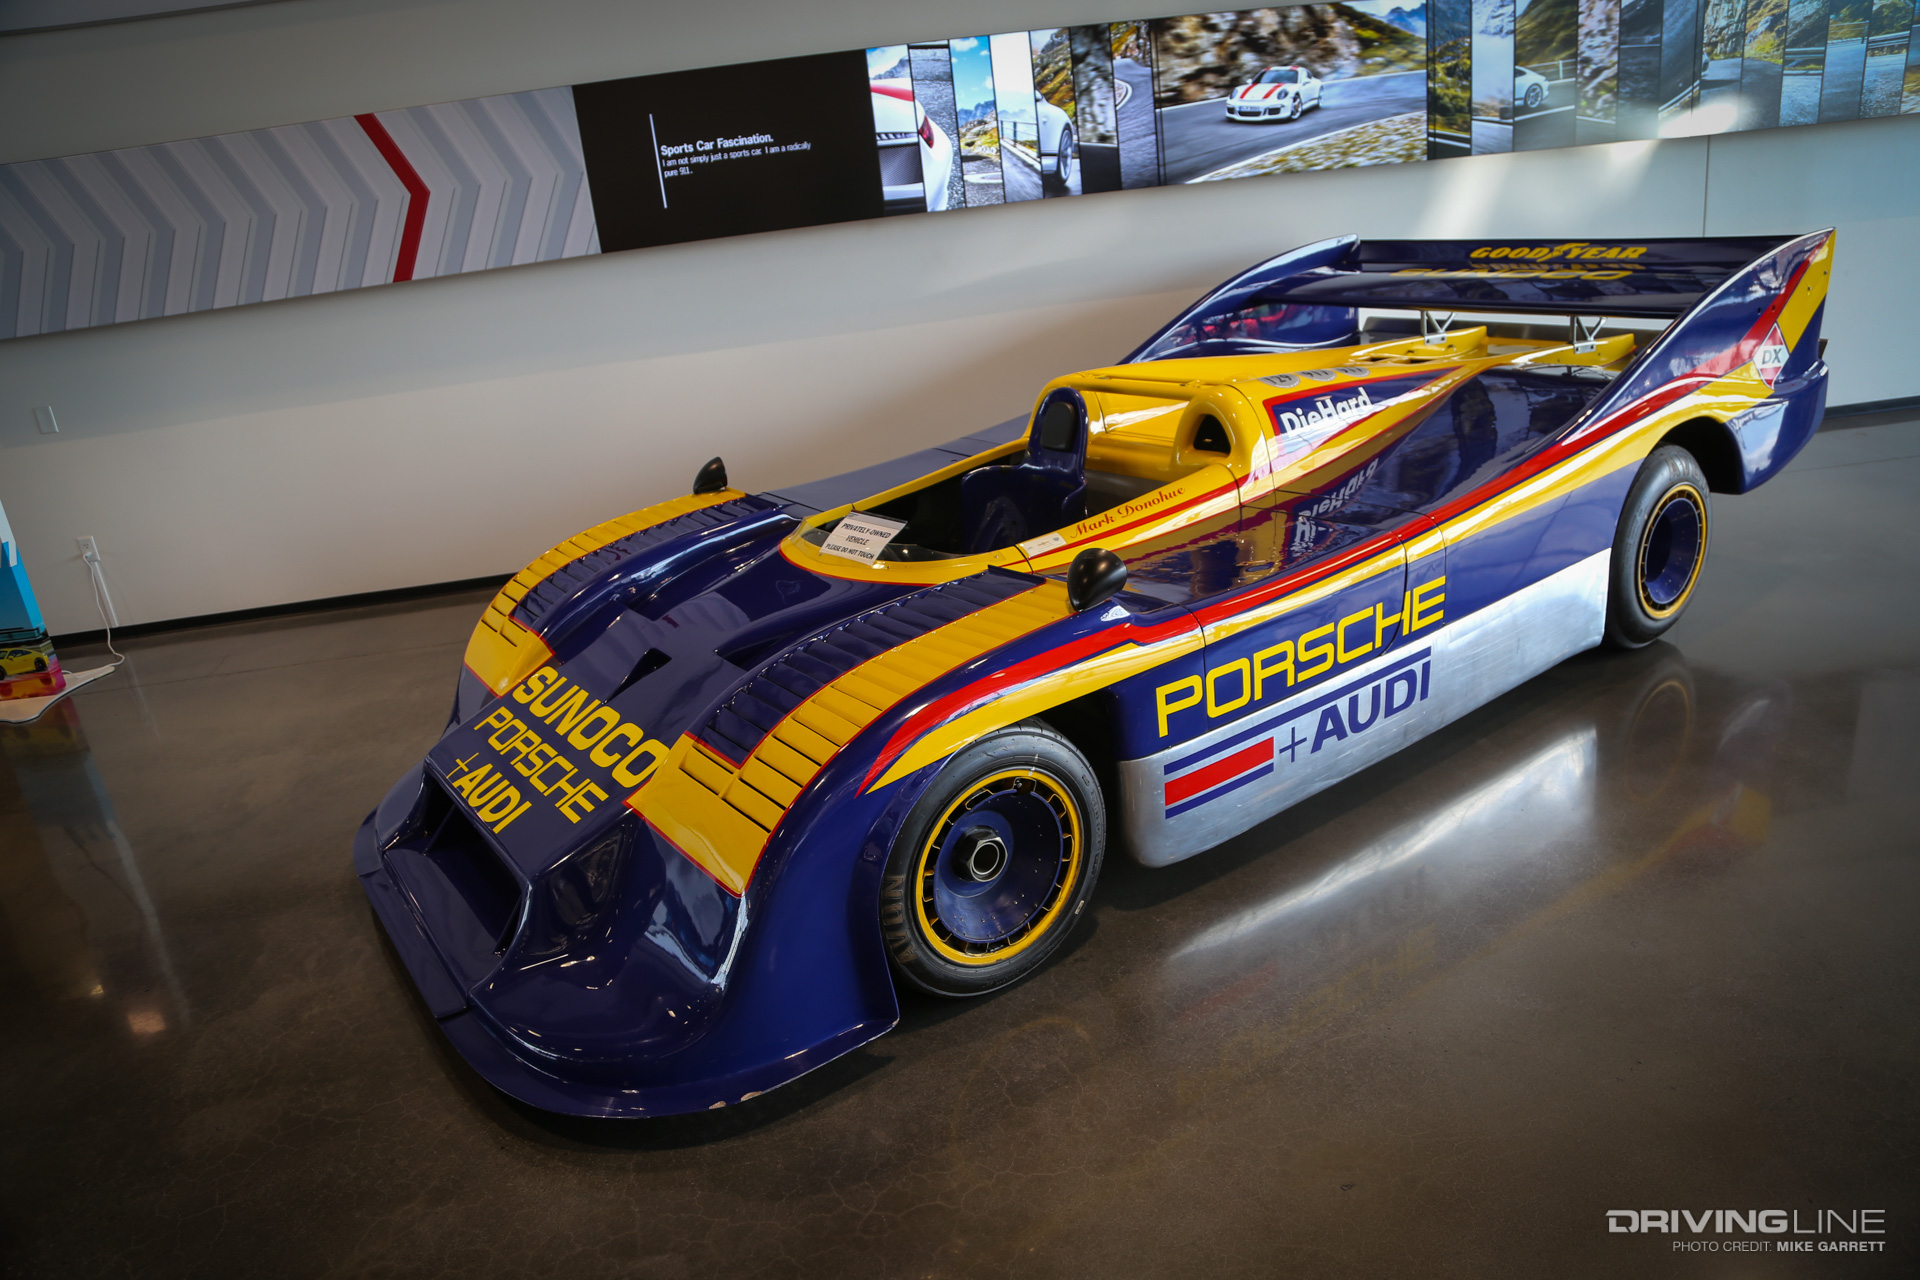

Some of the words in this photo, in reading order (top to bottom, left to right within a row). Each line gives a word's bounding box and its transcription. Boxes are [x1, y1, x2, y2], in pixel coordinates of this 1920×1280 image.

[660, 142, 694, 157] Sports
[696, 140, 714, 151] Car
[717, 133, 774, 149] Fascination.
[666, 158, 677, 167] am
[678, 156, 689, 165] not
[690, 154, 709, 165] simply
[710, 152, 722, 163] just
[729, 149, 750, 160] sports
[769, 146, 780, 154] am
[787, 141, 812, 151] radically
[664, 169, 678, 178] pure
[1762, 348, 1782, 365] DX
[1280, 386, 1371, 437] DieHard
[1070, 514, 1116, 539] Mark
[1117, 487, 1185, 518] Donohue
[841, 523, 891, 539] PRIVATELY-OWNED
[846, 535, 870, 546] VEHICLE
[825, 543, 841, 551] PLEASE
[858, 550, 875, 560] TOUCH
[1156, 575, 1446, 738] PORSCHE
[512, 666, 670, 788] SUNOCO
[473, 706, 609, 824] PORSCHE
